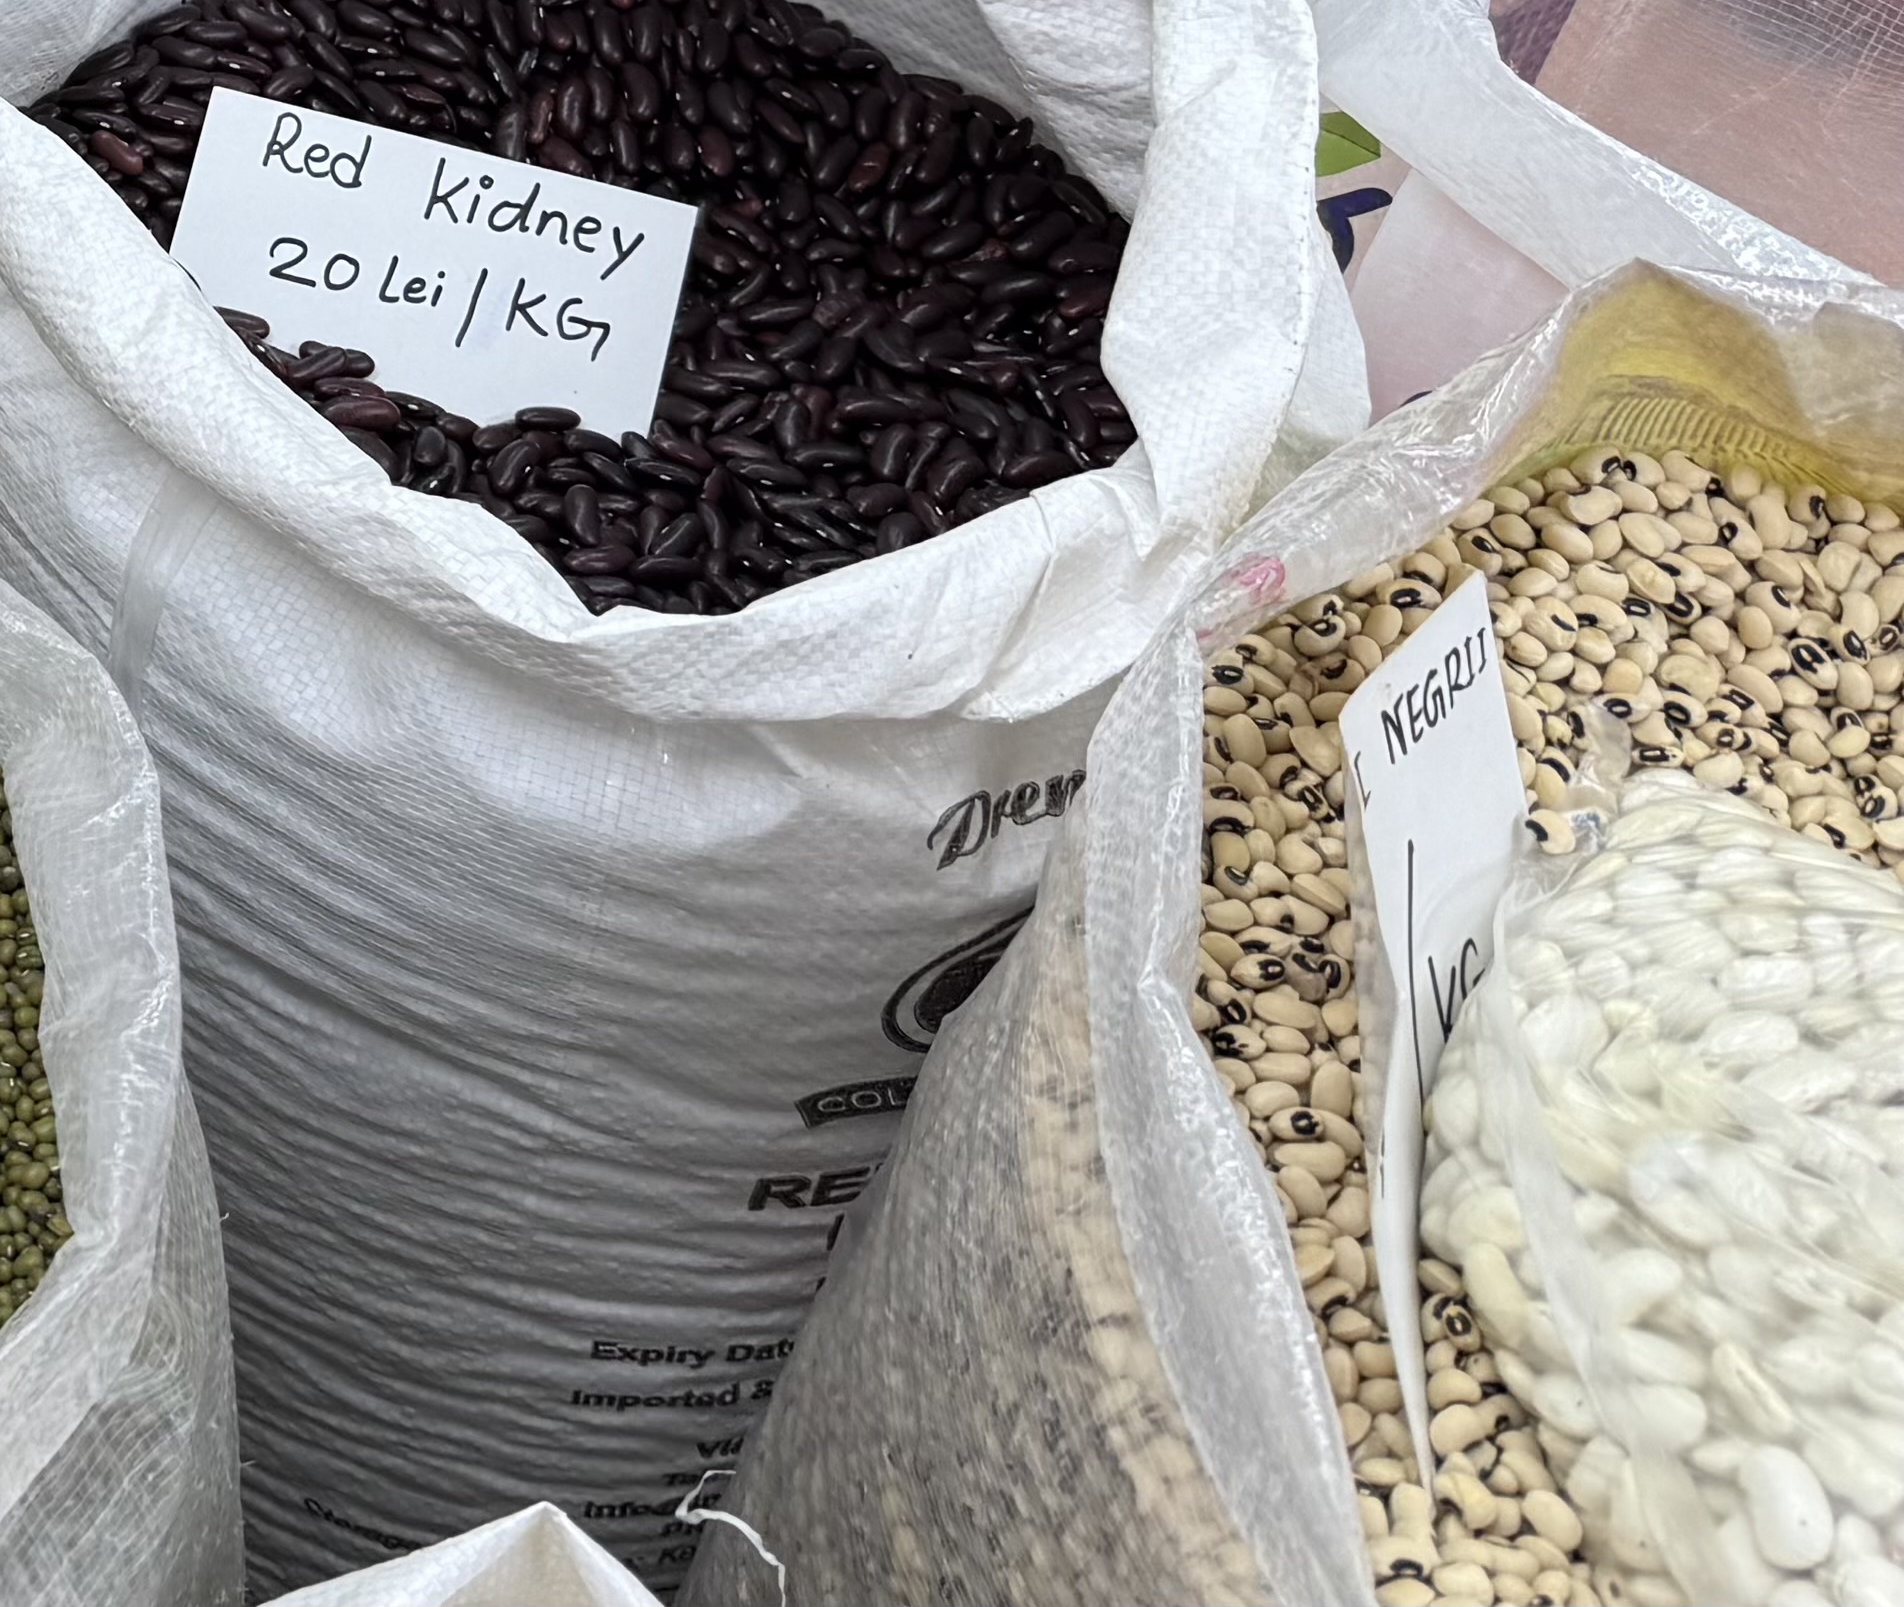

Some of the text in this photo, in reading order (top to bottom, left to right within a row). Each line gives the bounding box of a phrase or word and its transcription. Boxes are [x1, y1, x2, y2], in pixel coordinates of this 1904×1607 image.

[263, 112, 645, 281] Red Kidney
[269, 237, 361, 291] 20
[591, 1340, 716, 1370] Expiry
[571, 1383, 741, 1413] Imported
